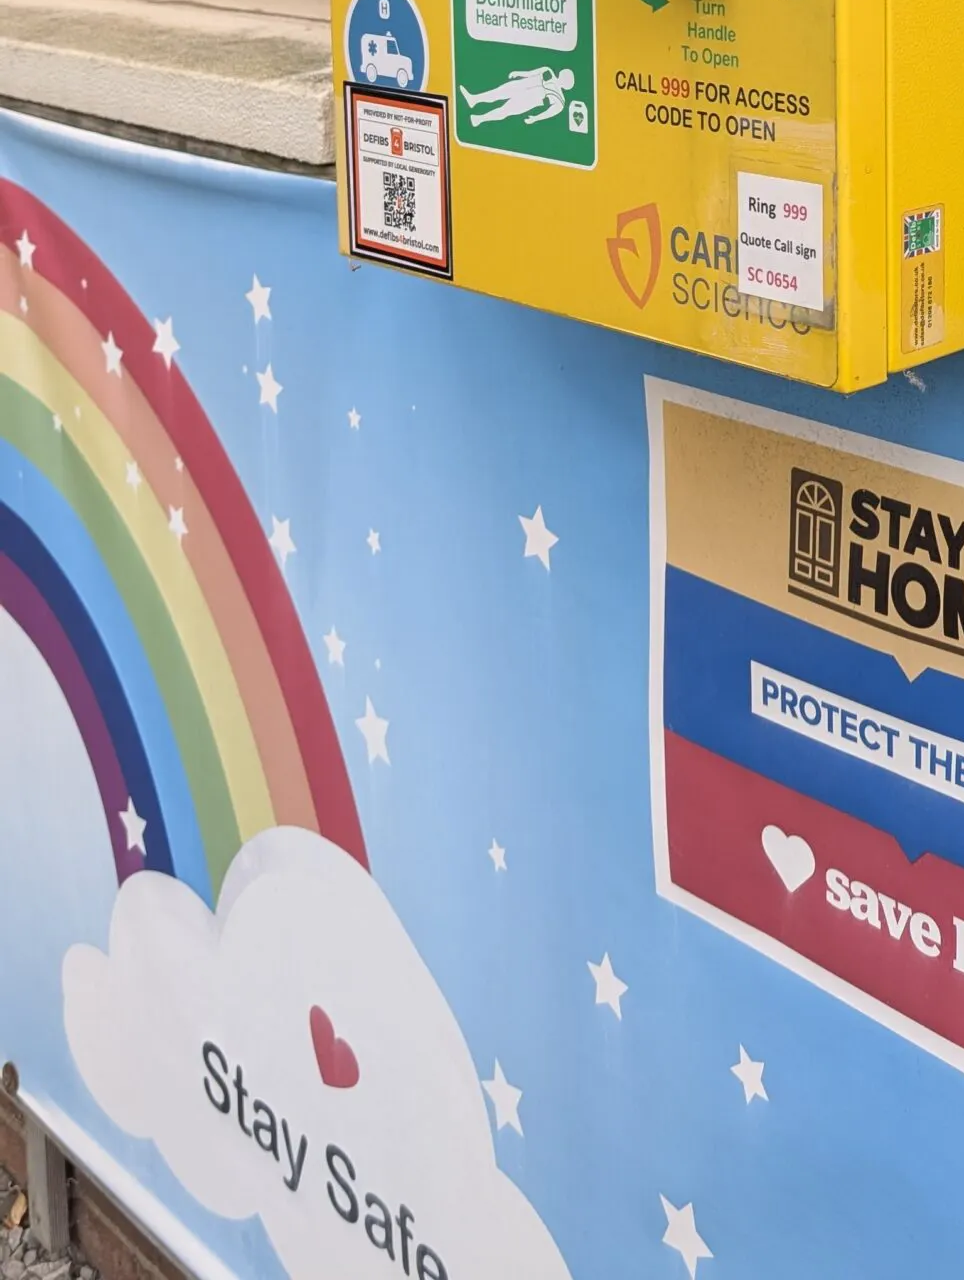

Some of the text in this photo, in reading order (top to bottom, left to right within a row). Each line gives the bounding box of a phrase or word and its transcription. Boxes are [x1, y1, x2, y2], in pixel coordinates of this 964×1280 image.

[476, 9, 567, 34] Heart Restarter
[688, 22, 736, 42] Handle
[681, 45, 739, 68] To Open
[615, 70, 810, 116] CALL 999 FOR ACCESS
[645, 103, 776, 142] CODE TO OPEN
[363, 133, 389, 147] DEFIBS
[403, 141, 435, 156] BRISTOL
[748, 196, 808, 221] Ring 999
[363, 227, 439, 253] www.defibs4bristol.com
[670, 226, 739, 275] CAR
[740, 232, 816, 260] Quote Call sign
[748, 266, 798, 291] SC 0654
[762, 676, 900, 758] PROTECT
[826, 868, 942, 958] save
[202, 1040, 308, 1192] Stay
